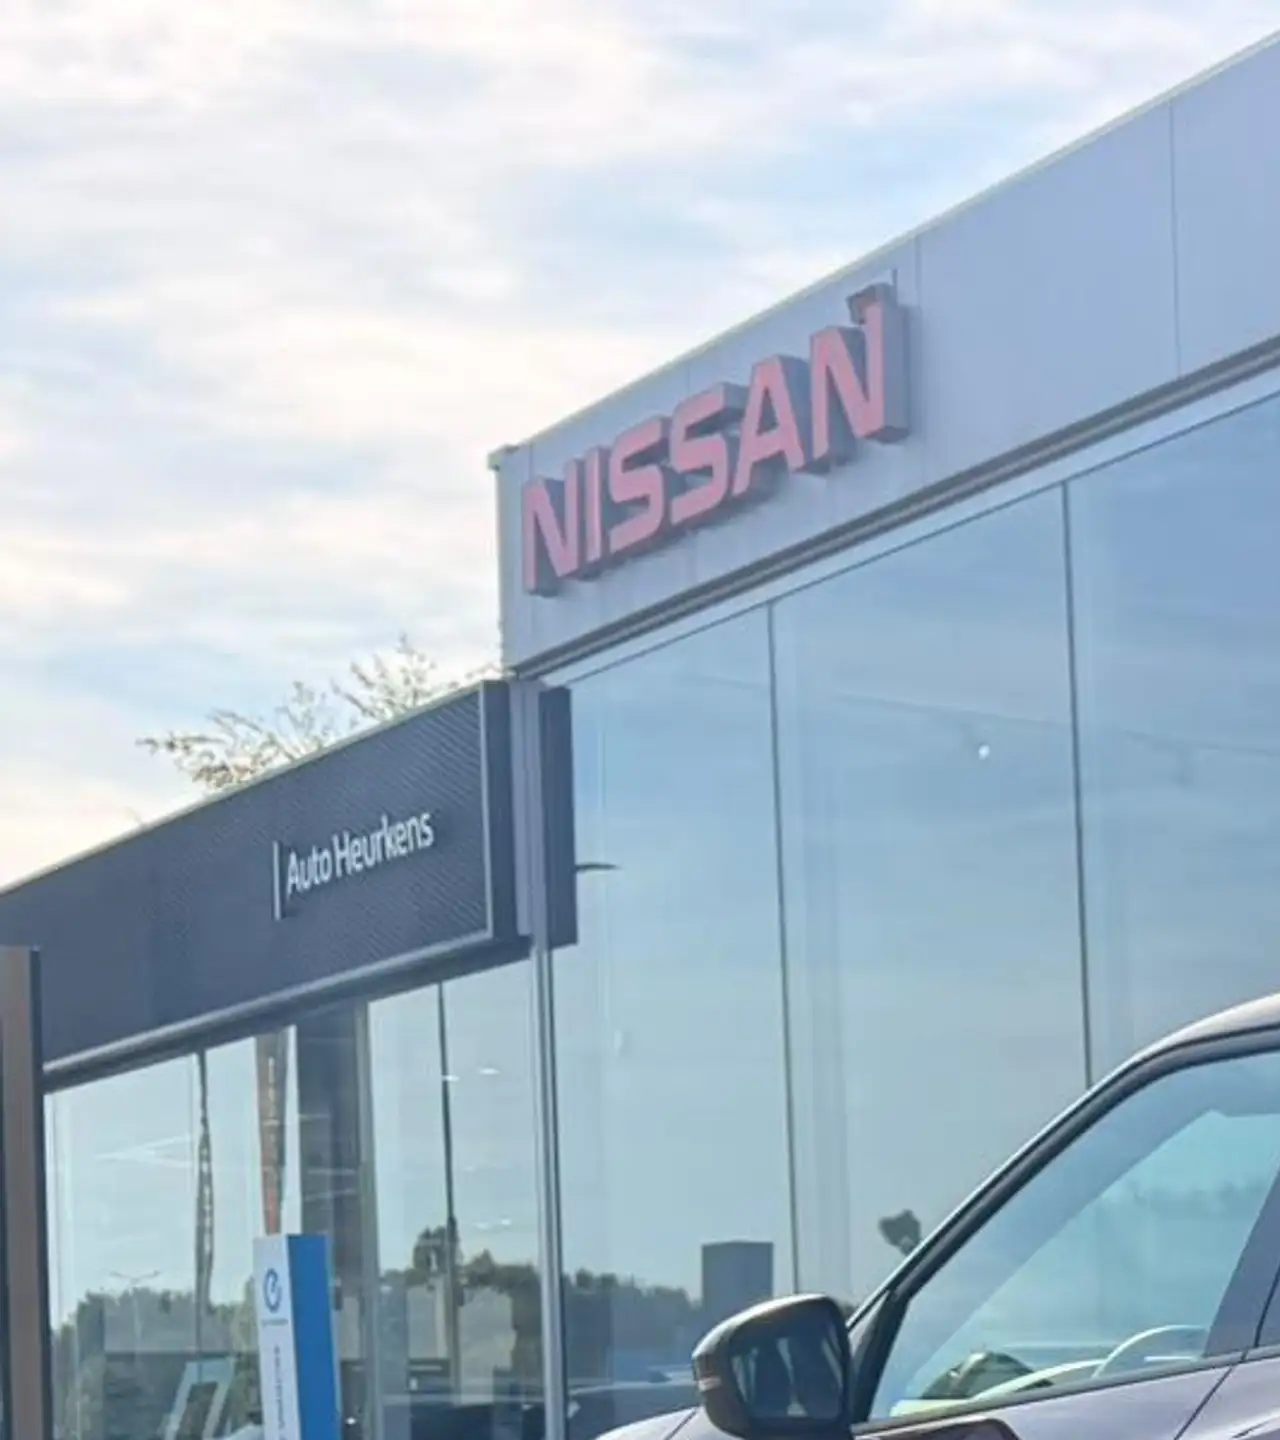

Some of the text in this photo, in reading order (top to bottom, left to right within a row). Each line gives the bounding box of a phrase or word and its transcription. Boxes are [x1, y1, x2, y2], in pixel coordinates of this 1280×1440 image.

[522, 284, 902, 598] NISSAN
[286, 812, 434, 900] Auto Heurkens
